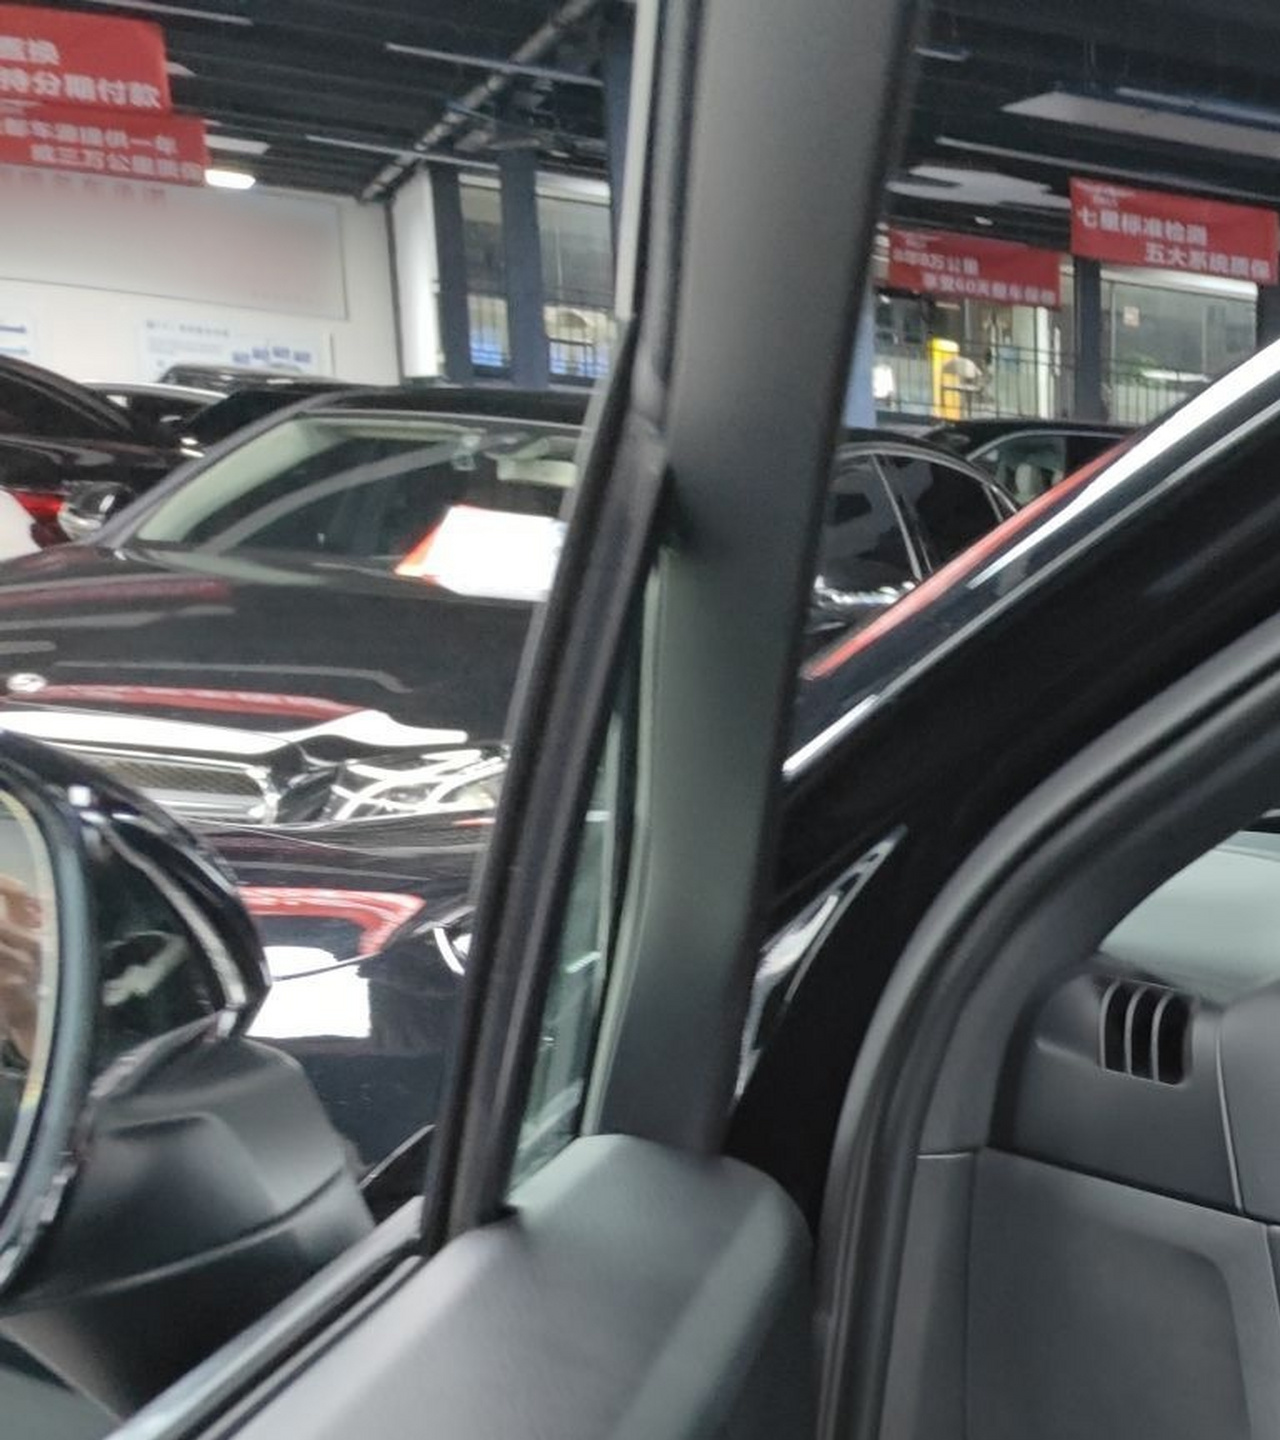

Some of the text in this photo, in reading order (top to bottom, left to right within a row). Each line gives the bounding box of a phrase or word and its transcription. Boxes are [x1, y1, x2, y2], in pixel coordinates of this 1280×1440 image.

[0, 117, 177, 155] 部车源提供一年
